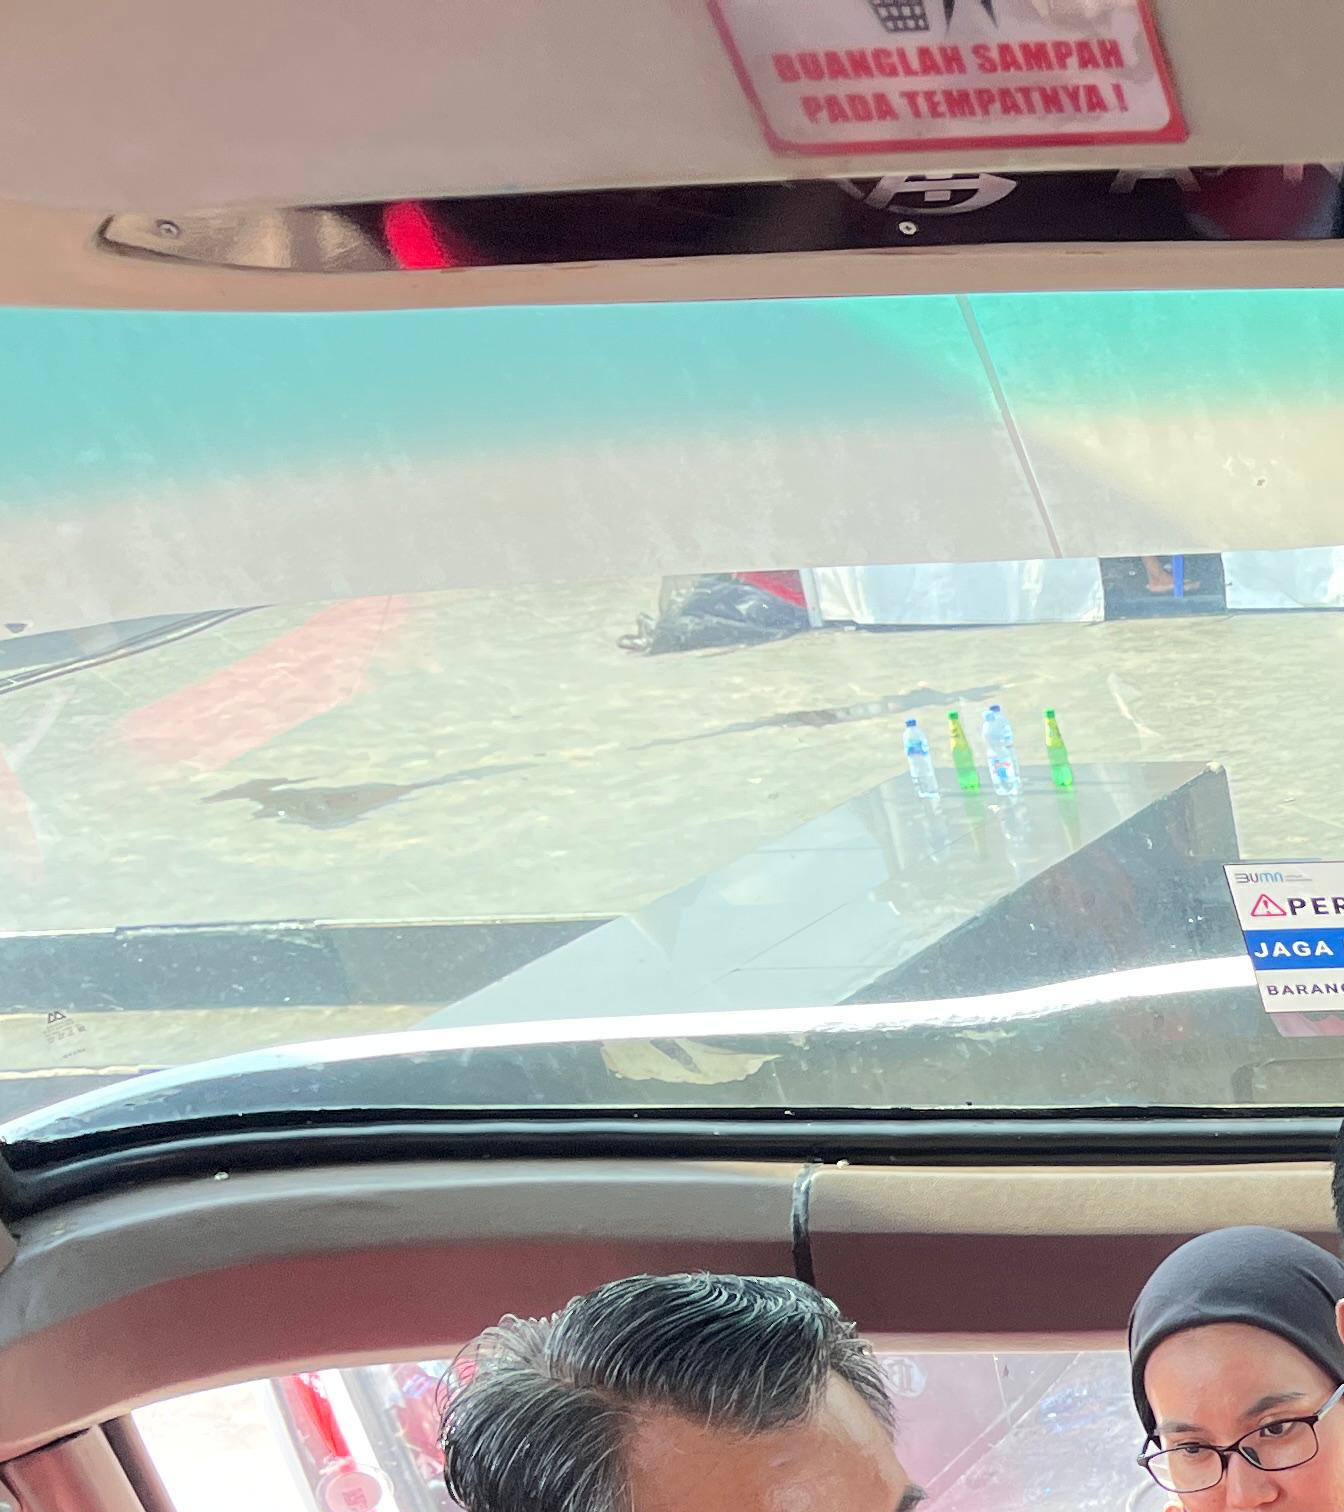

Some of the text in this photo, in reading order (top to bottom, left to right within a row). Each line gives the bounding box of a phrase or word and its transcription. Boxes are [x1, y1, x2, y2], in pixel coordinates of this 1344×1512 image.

[773, 40, 1125, 83] BUANGLAH SAMPAH
[801, 92, 899, 124] PADA
[903, 84, 1107, 119] TEMPATNYA
[1253, 940, 1334, 958] JAGA
